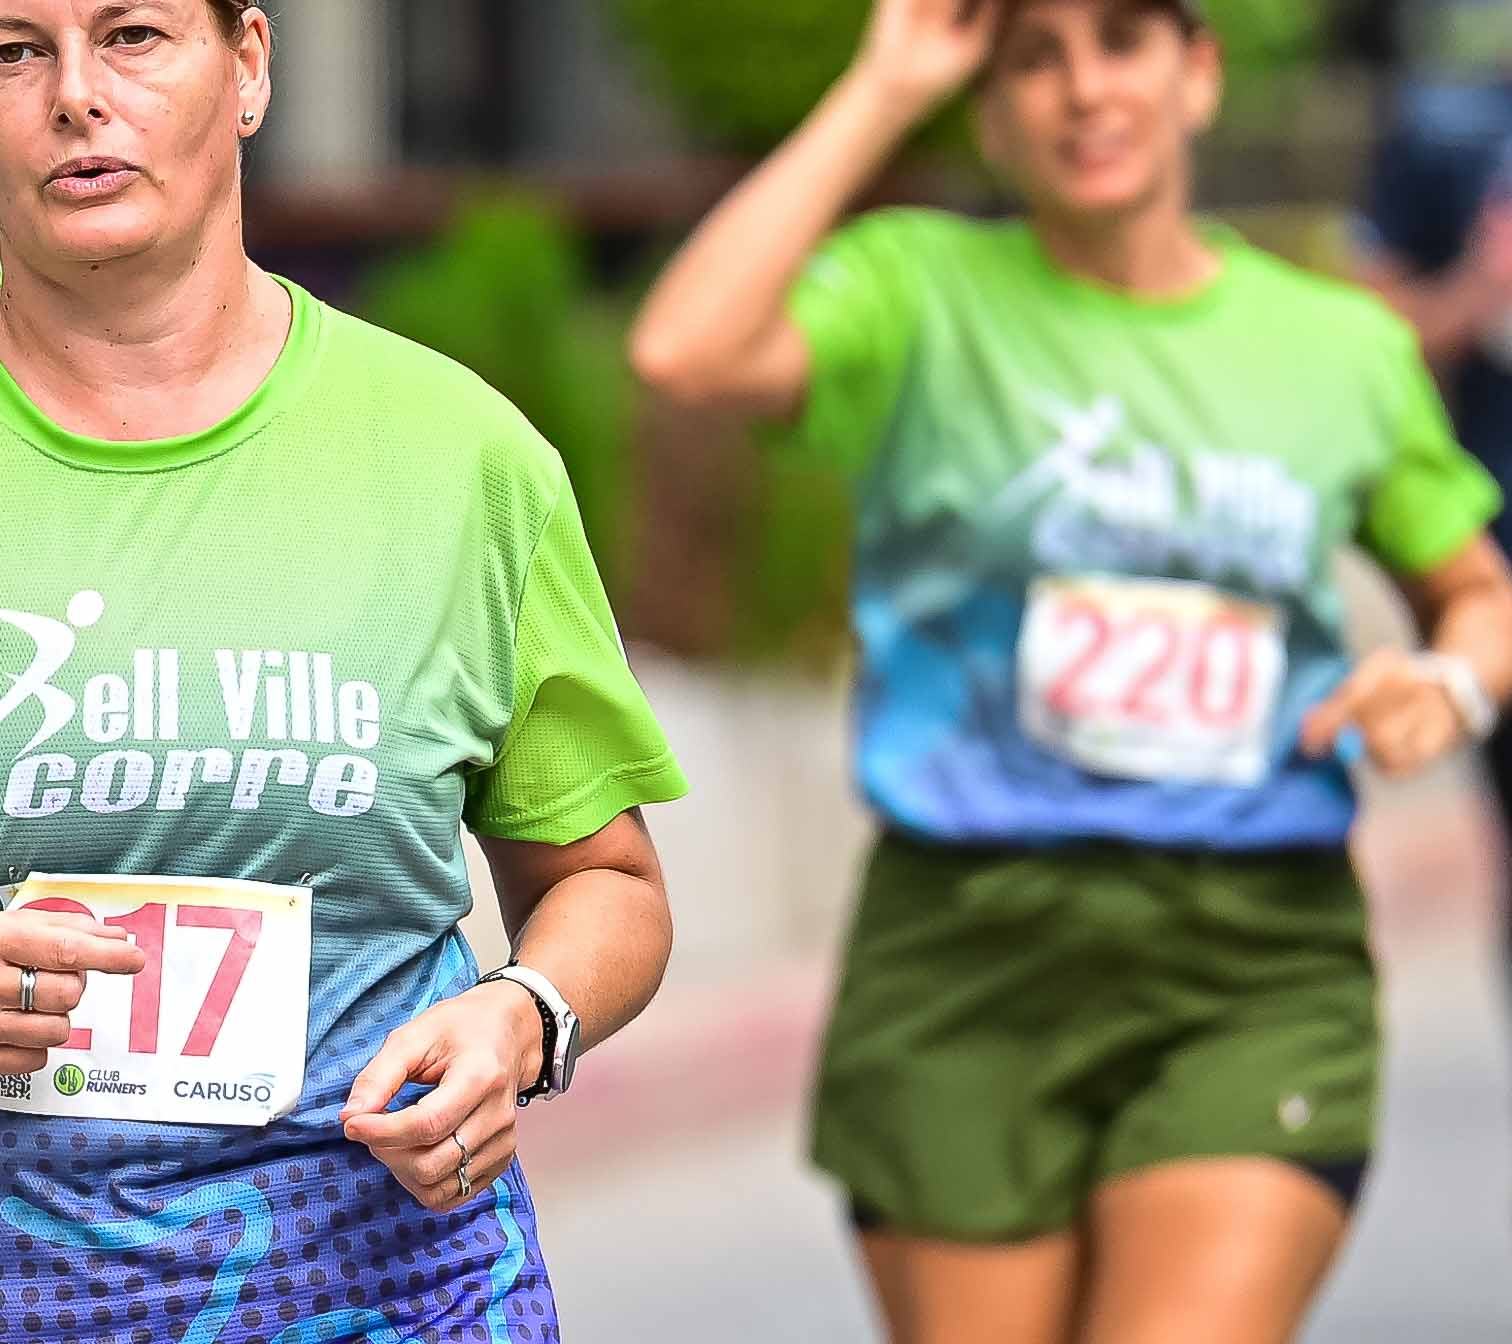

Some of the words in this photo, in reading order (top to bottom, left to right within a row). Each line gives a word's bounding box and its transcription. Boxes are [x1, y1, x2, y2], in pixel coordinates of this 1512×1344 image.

[1045, 598, 1254, 730] 220
[214, 649, 380, 749] Ville
[2, 747, 379, 818] corre
[86, 1081, 146, 1095] RUNNER'S
[89, 1069, 120, 1082] CLUB
[174, 1080, 271, 1102] CARUSO
